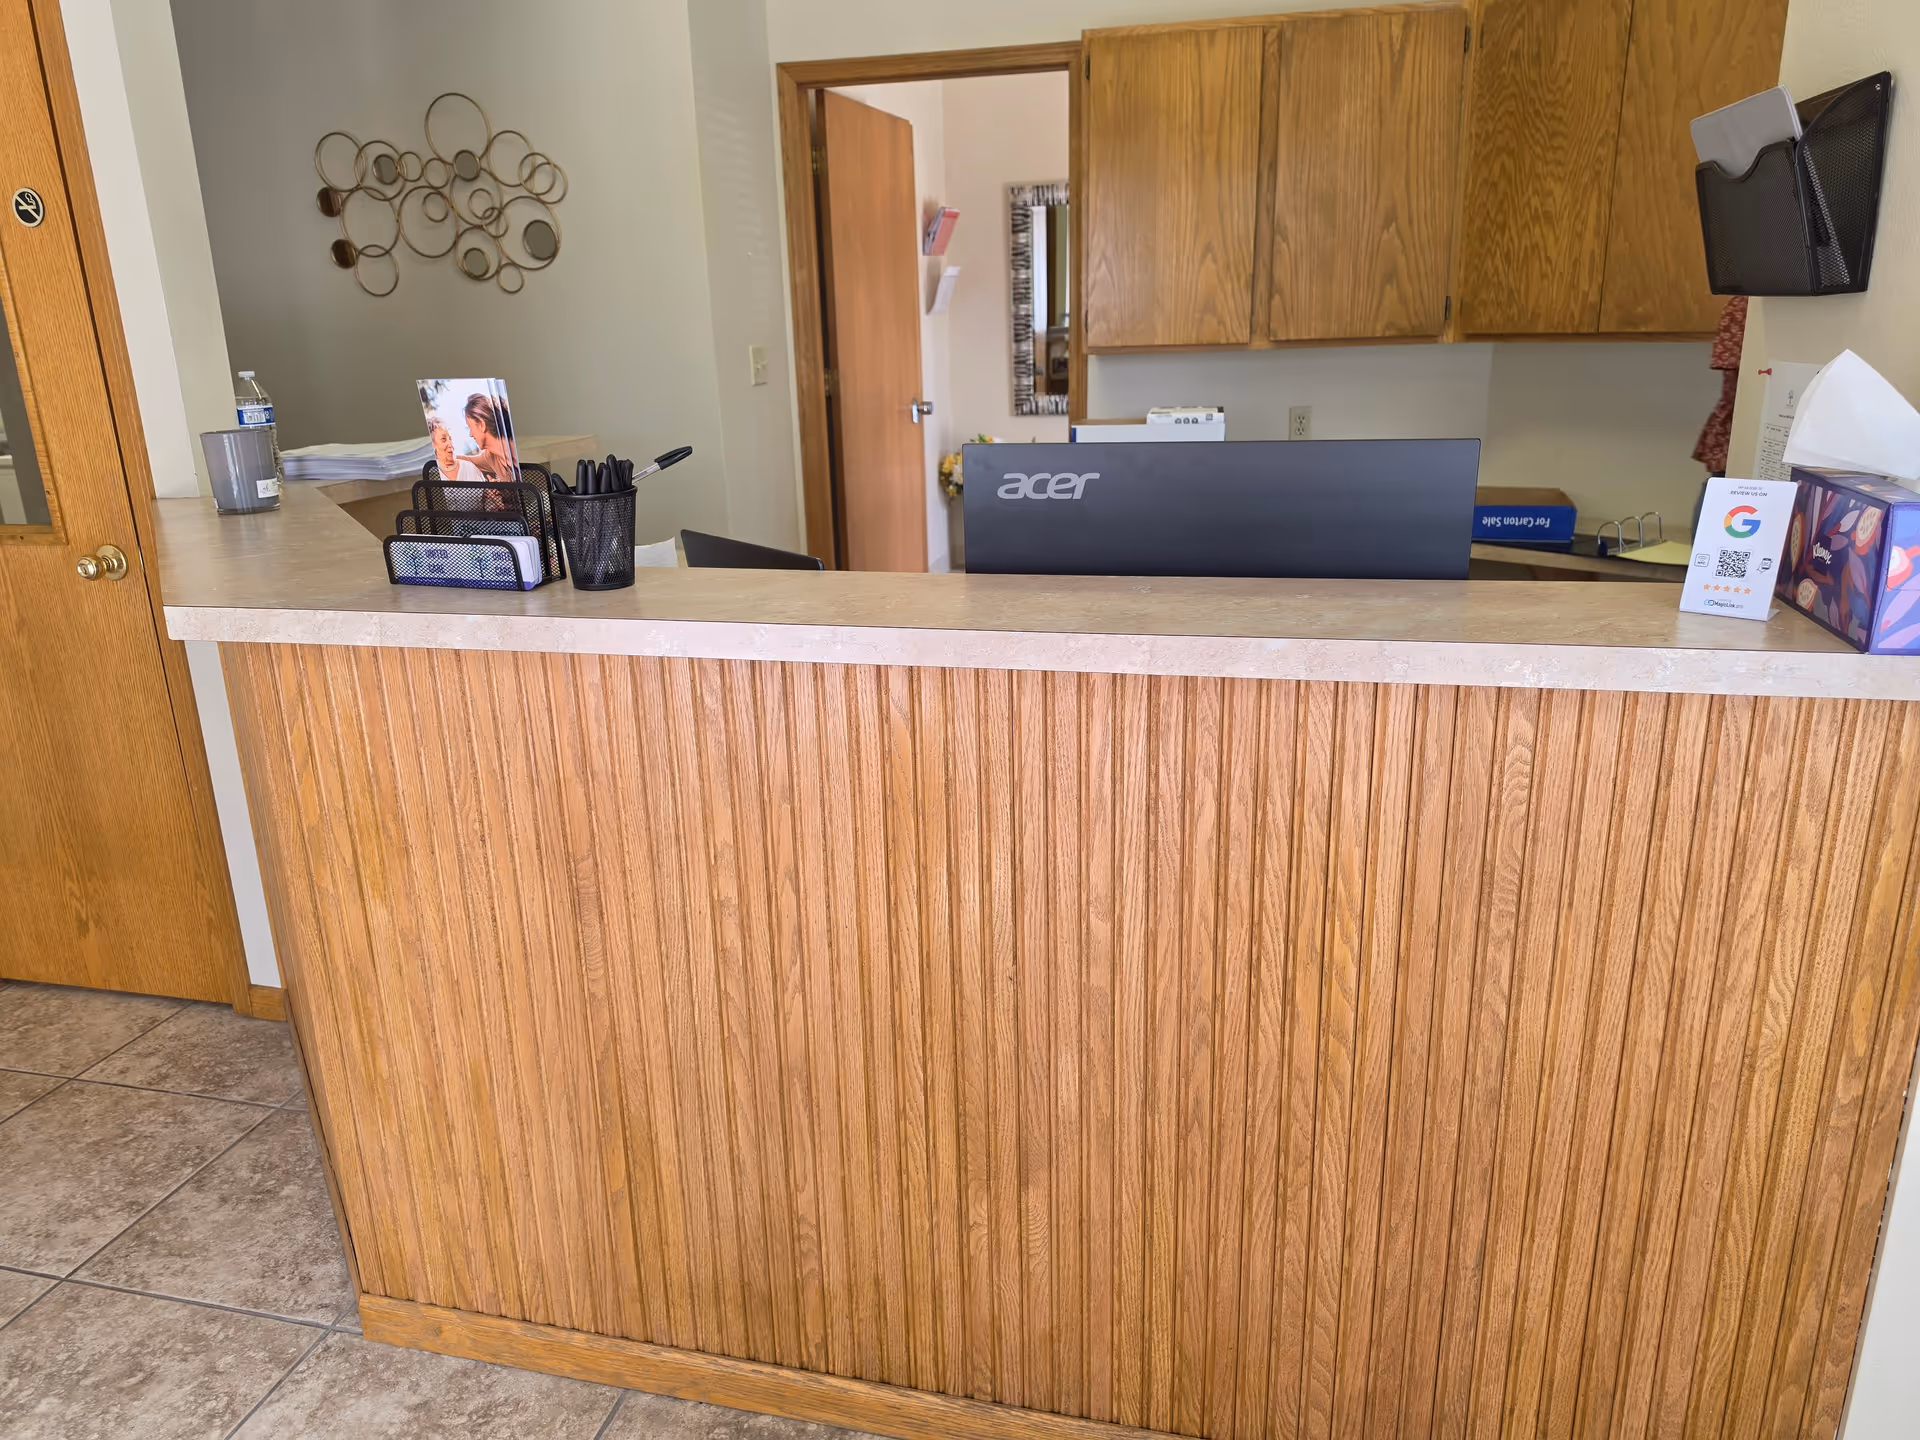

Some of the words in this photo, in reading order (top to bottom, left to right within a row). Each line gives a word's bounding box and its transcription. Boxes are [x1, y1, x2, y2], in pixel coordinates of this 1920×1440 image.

[997, 472, 1101, 500] acer
[1482, 516, 1502, 528] Sale
[1503, 516, 1534, 528] Carton
[1534, 517, 1550, 528] For
